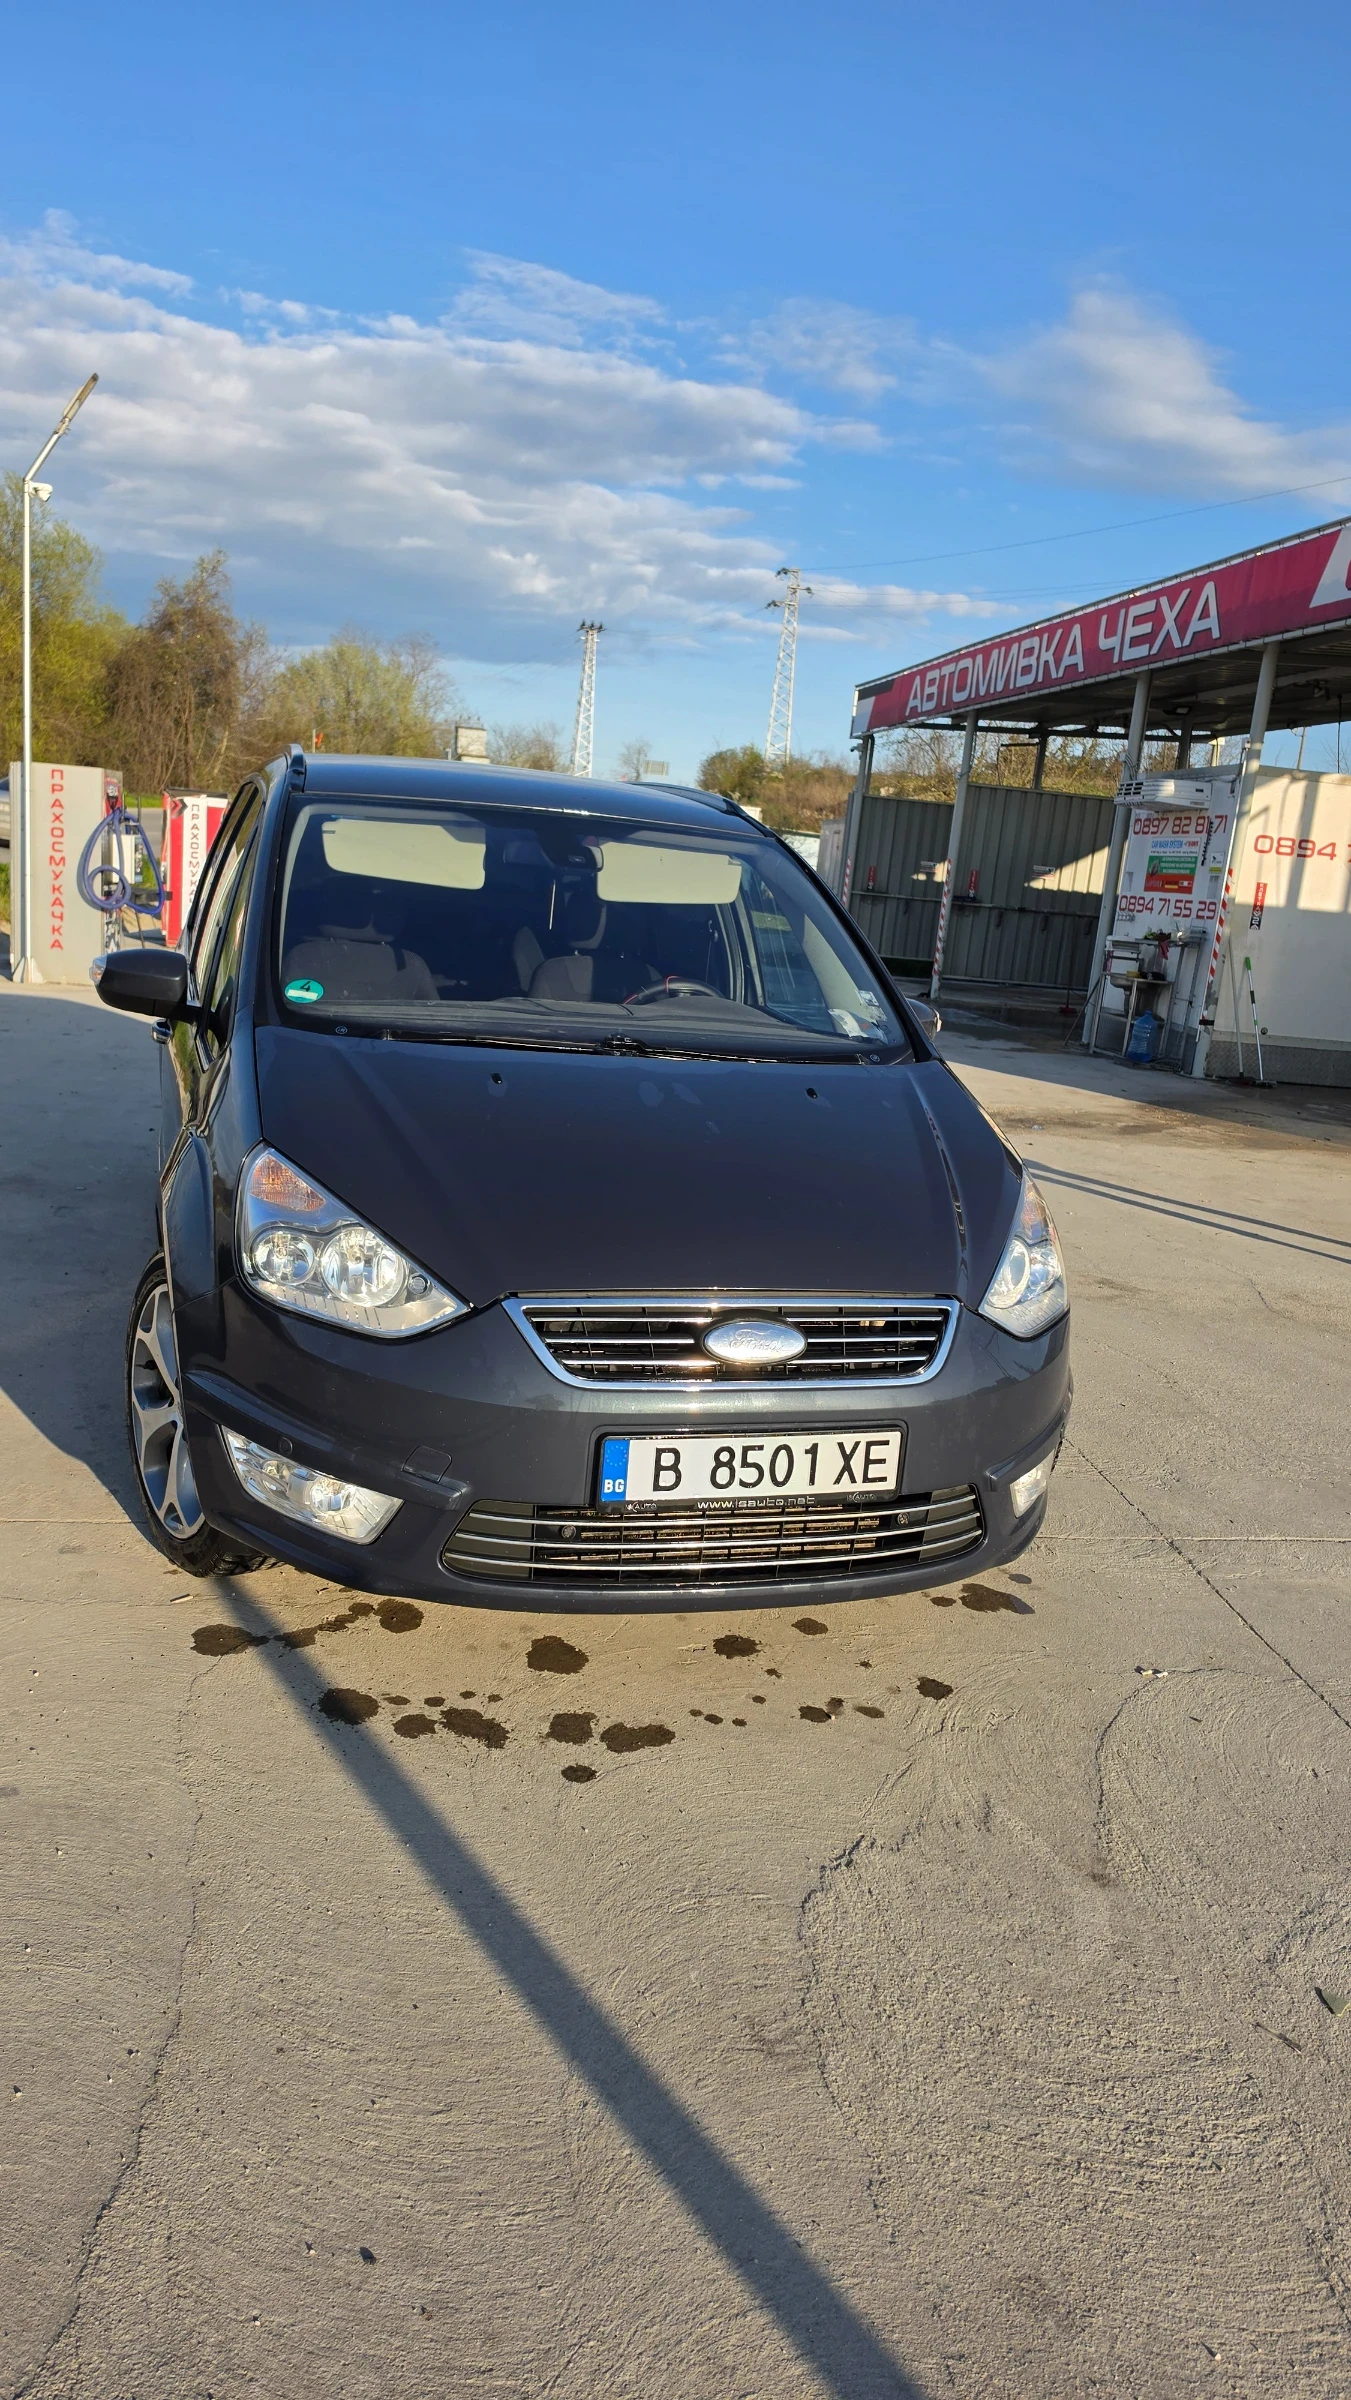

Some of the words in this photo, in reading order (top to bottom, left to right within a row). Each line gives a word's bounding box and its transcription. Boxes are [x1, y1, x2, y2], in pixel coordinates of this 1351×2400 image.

[905, 623, 1085, 717] АВТОМИВКА
[1098, 580, 1221, 664] ЧЕХА
[1133, 816, 1170, 836] 0897
[1171, 815, 1192, 835] 82
[1213, 815, 1228, 834] 71
[48, 769, 67, 950] ПРАХОСМУКАЧКА
[1253, 834, 1337, 861] 0894
[1118, 894, 1155, 917] 0894
[1157, 898, 1171, 918] 71
[1172, 899, 1194, 919] 55
[1195, 901, 1217, 921] 29
[299, 980, 311, 992] 4
[730, 1328, 784, 1352] Ford
[653, 1447, 682, 1492] B
[709, 1442, 820, 1490] 8501
[832, 1439, 891, 1485] XE
[603, 1479, 625, 1493] BG
